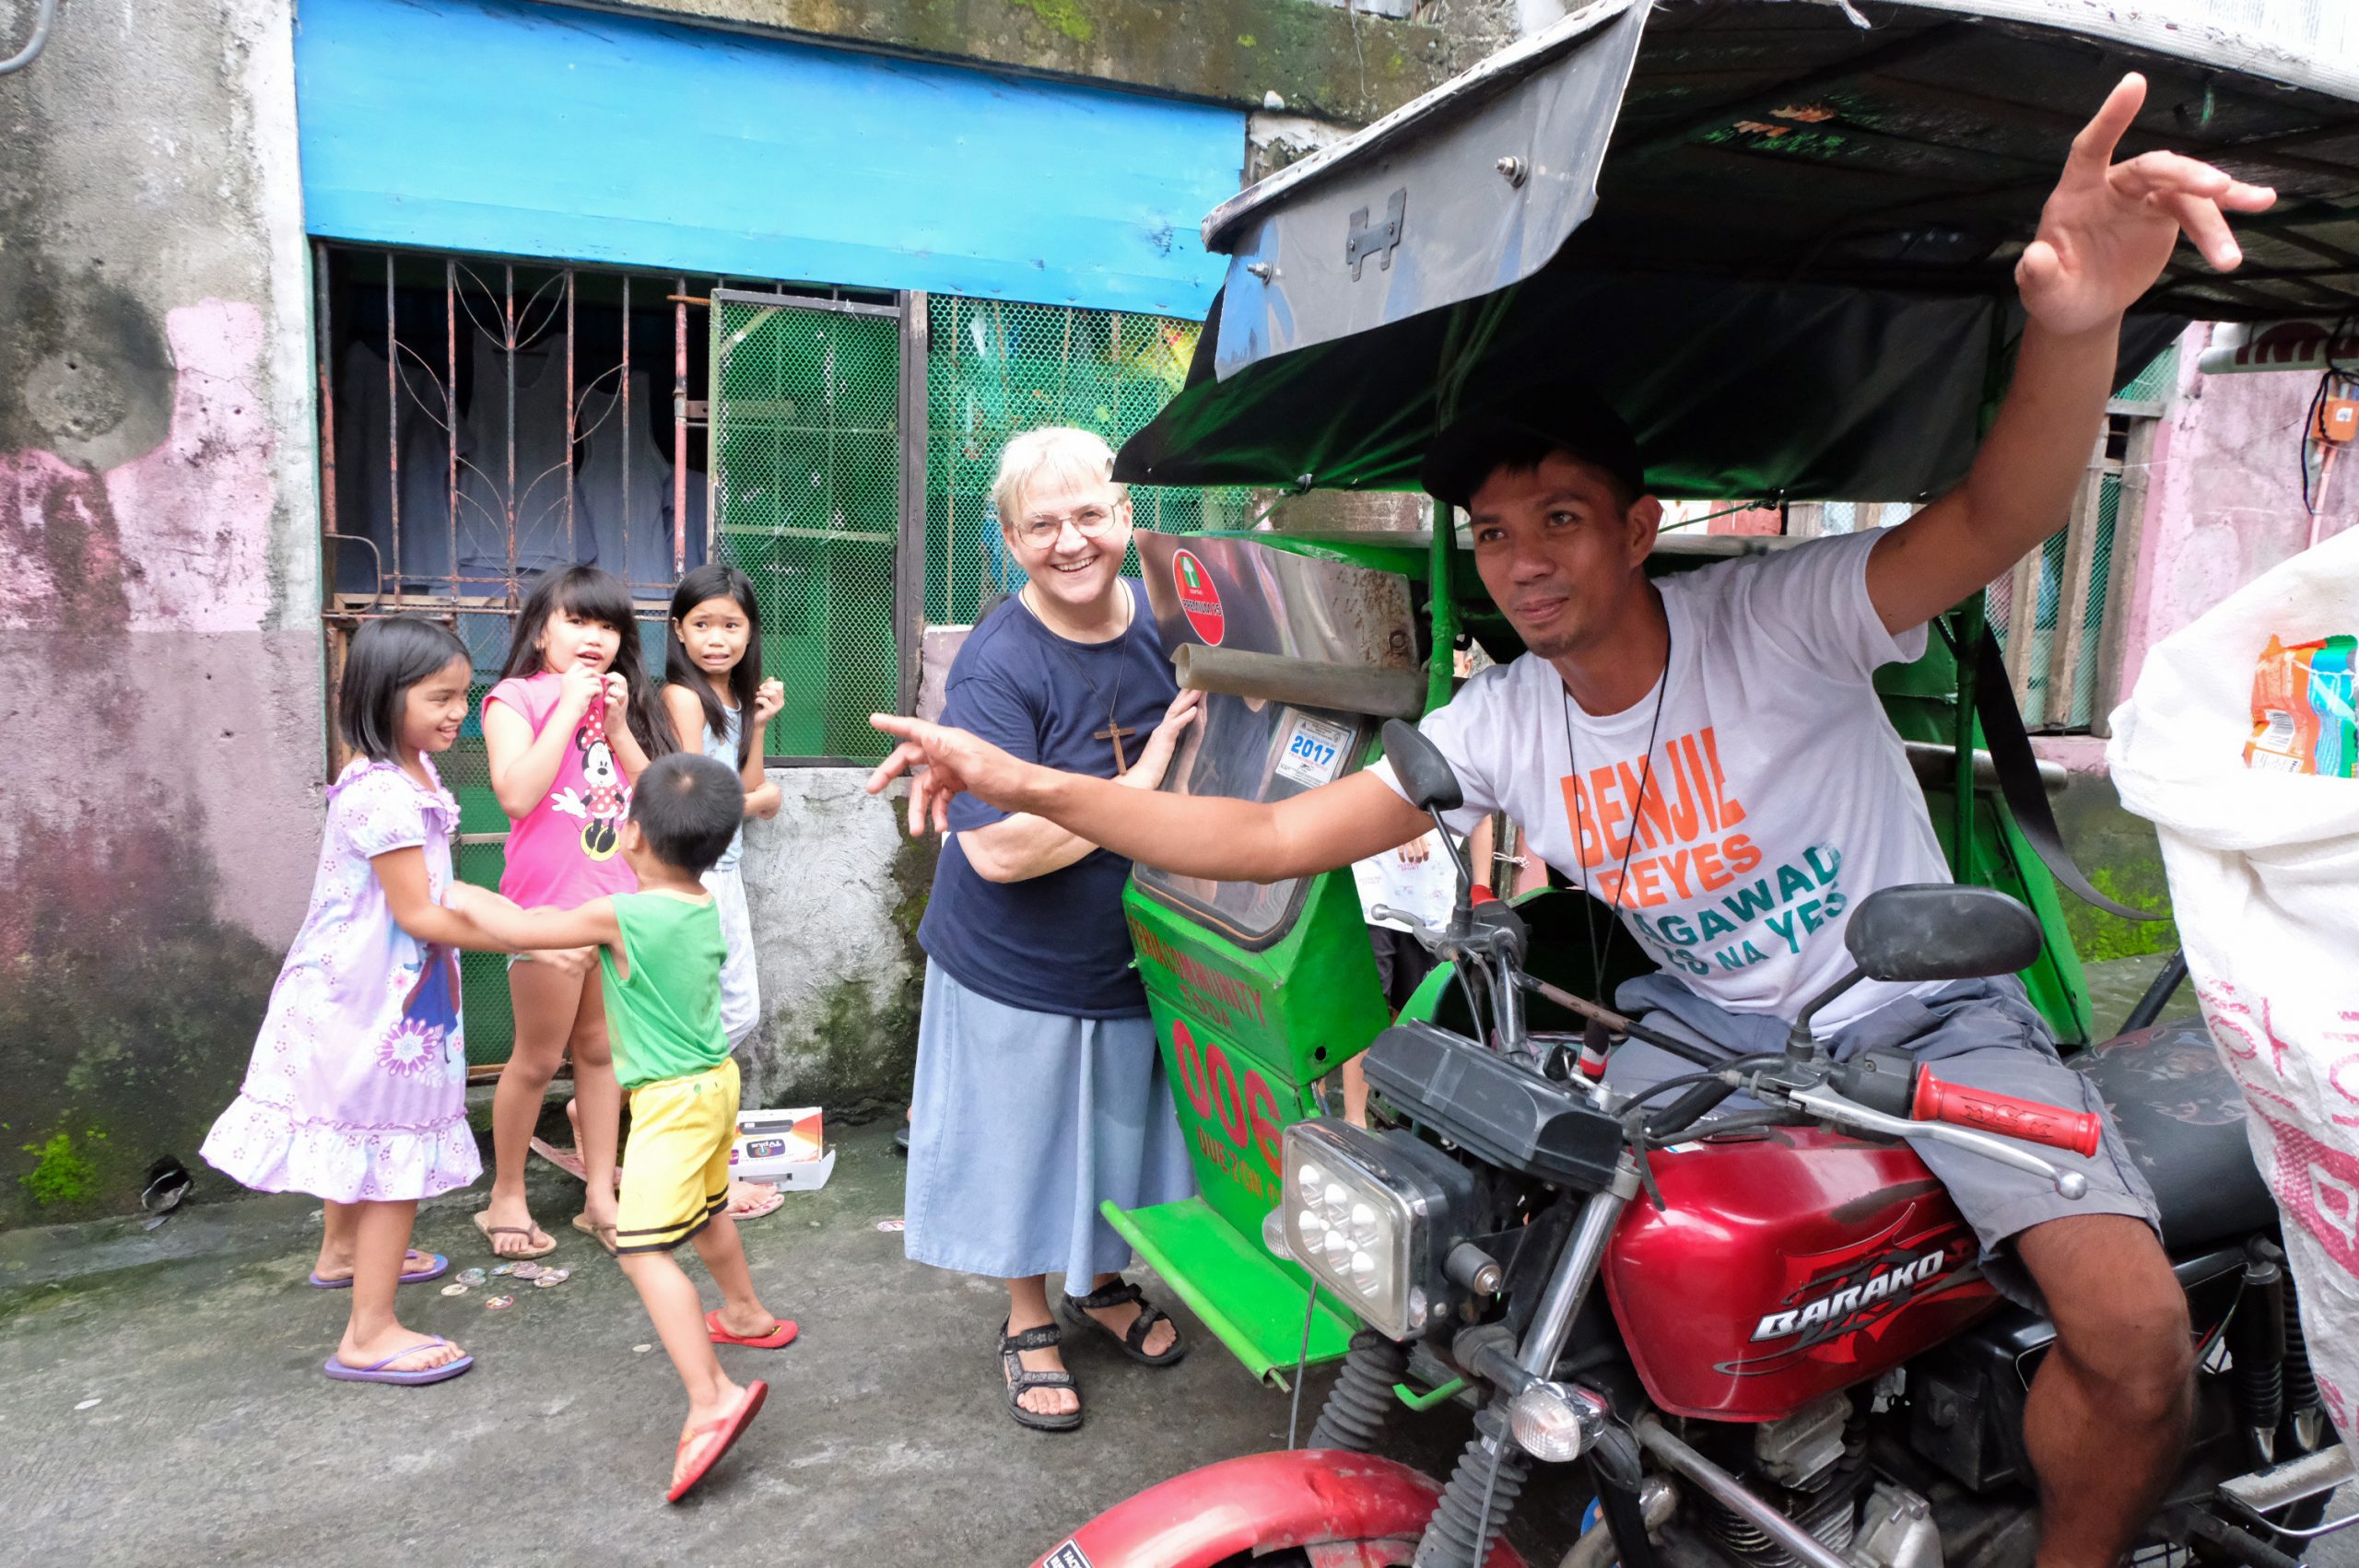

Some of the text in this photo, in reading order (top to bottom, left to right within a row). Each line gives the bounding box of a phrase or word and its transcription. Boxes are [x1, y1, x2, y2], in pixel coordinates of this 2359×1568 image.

[1290, 735, 1335, 766] 2017
[1597, 833, 1762, 908] REYES
[1615, 843, 1842, 946] AGAWAD
[1163, 941, 1267, 1029] COMMUNITY
[1716, 940, 1770, 971] NA
[1173, 1019, 1283, 1180] 006
[1751, 1249, 1944, 1342] BARAKO
